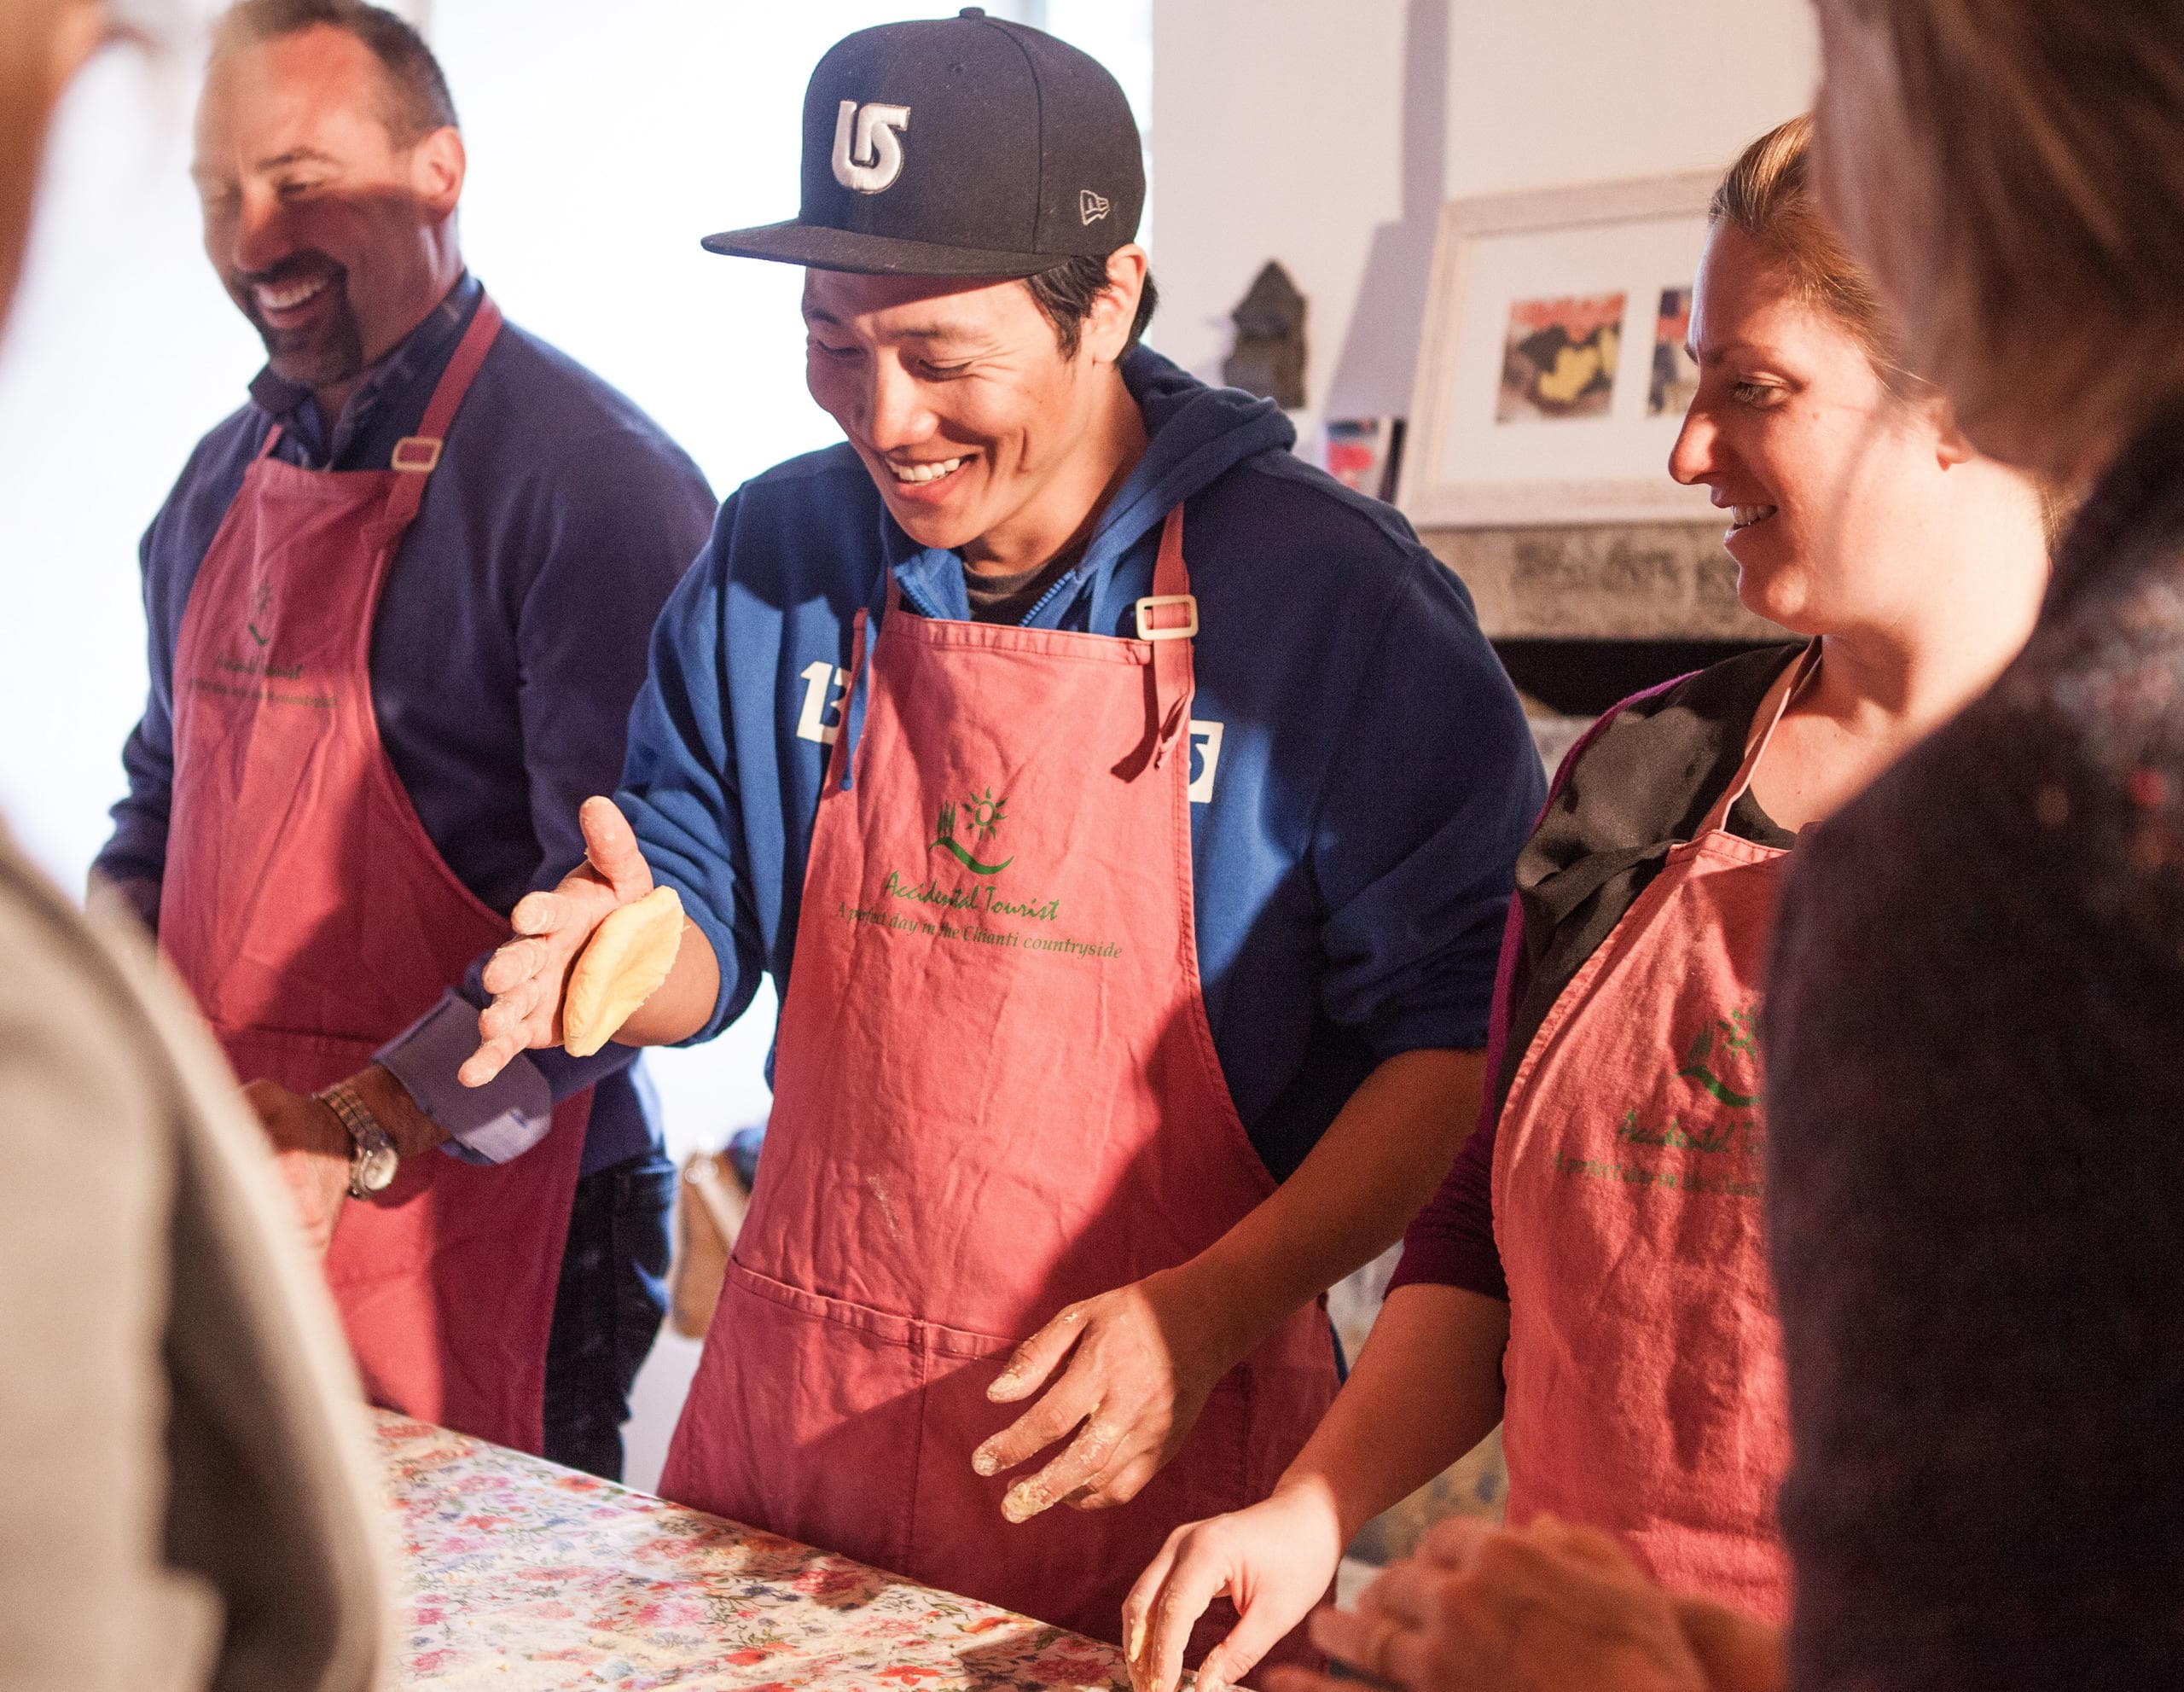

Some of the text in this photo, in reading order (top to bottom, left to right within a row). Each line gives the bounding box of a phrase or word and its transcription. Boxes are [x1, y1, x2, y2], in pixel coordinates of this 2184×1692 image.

[883, 870, 1060, 922] Accidental Tourist
[888, 913, 920, 937] day
[921, 918, 936, 936] in
[938, 920, 961, 939] the
[962, 924, 1019, 948] Chianti
[1023, 936, 1124, 960] countryside
